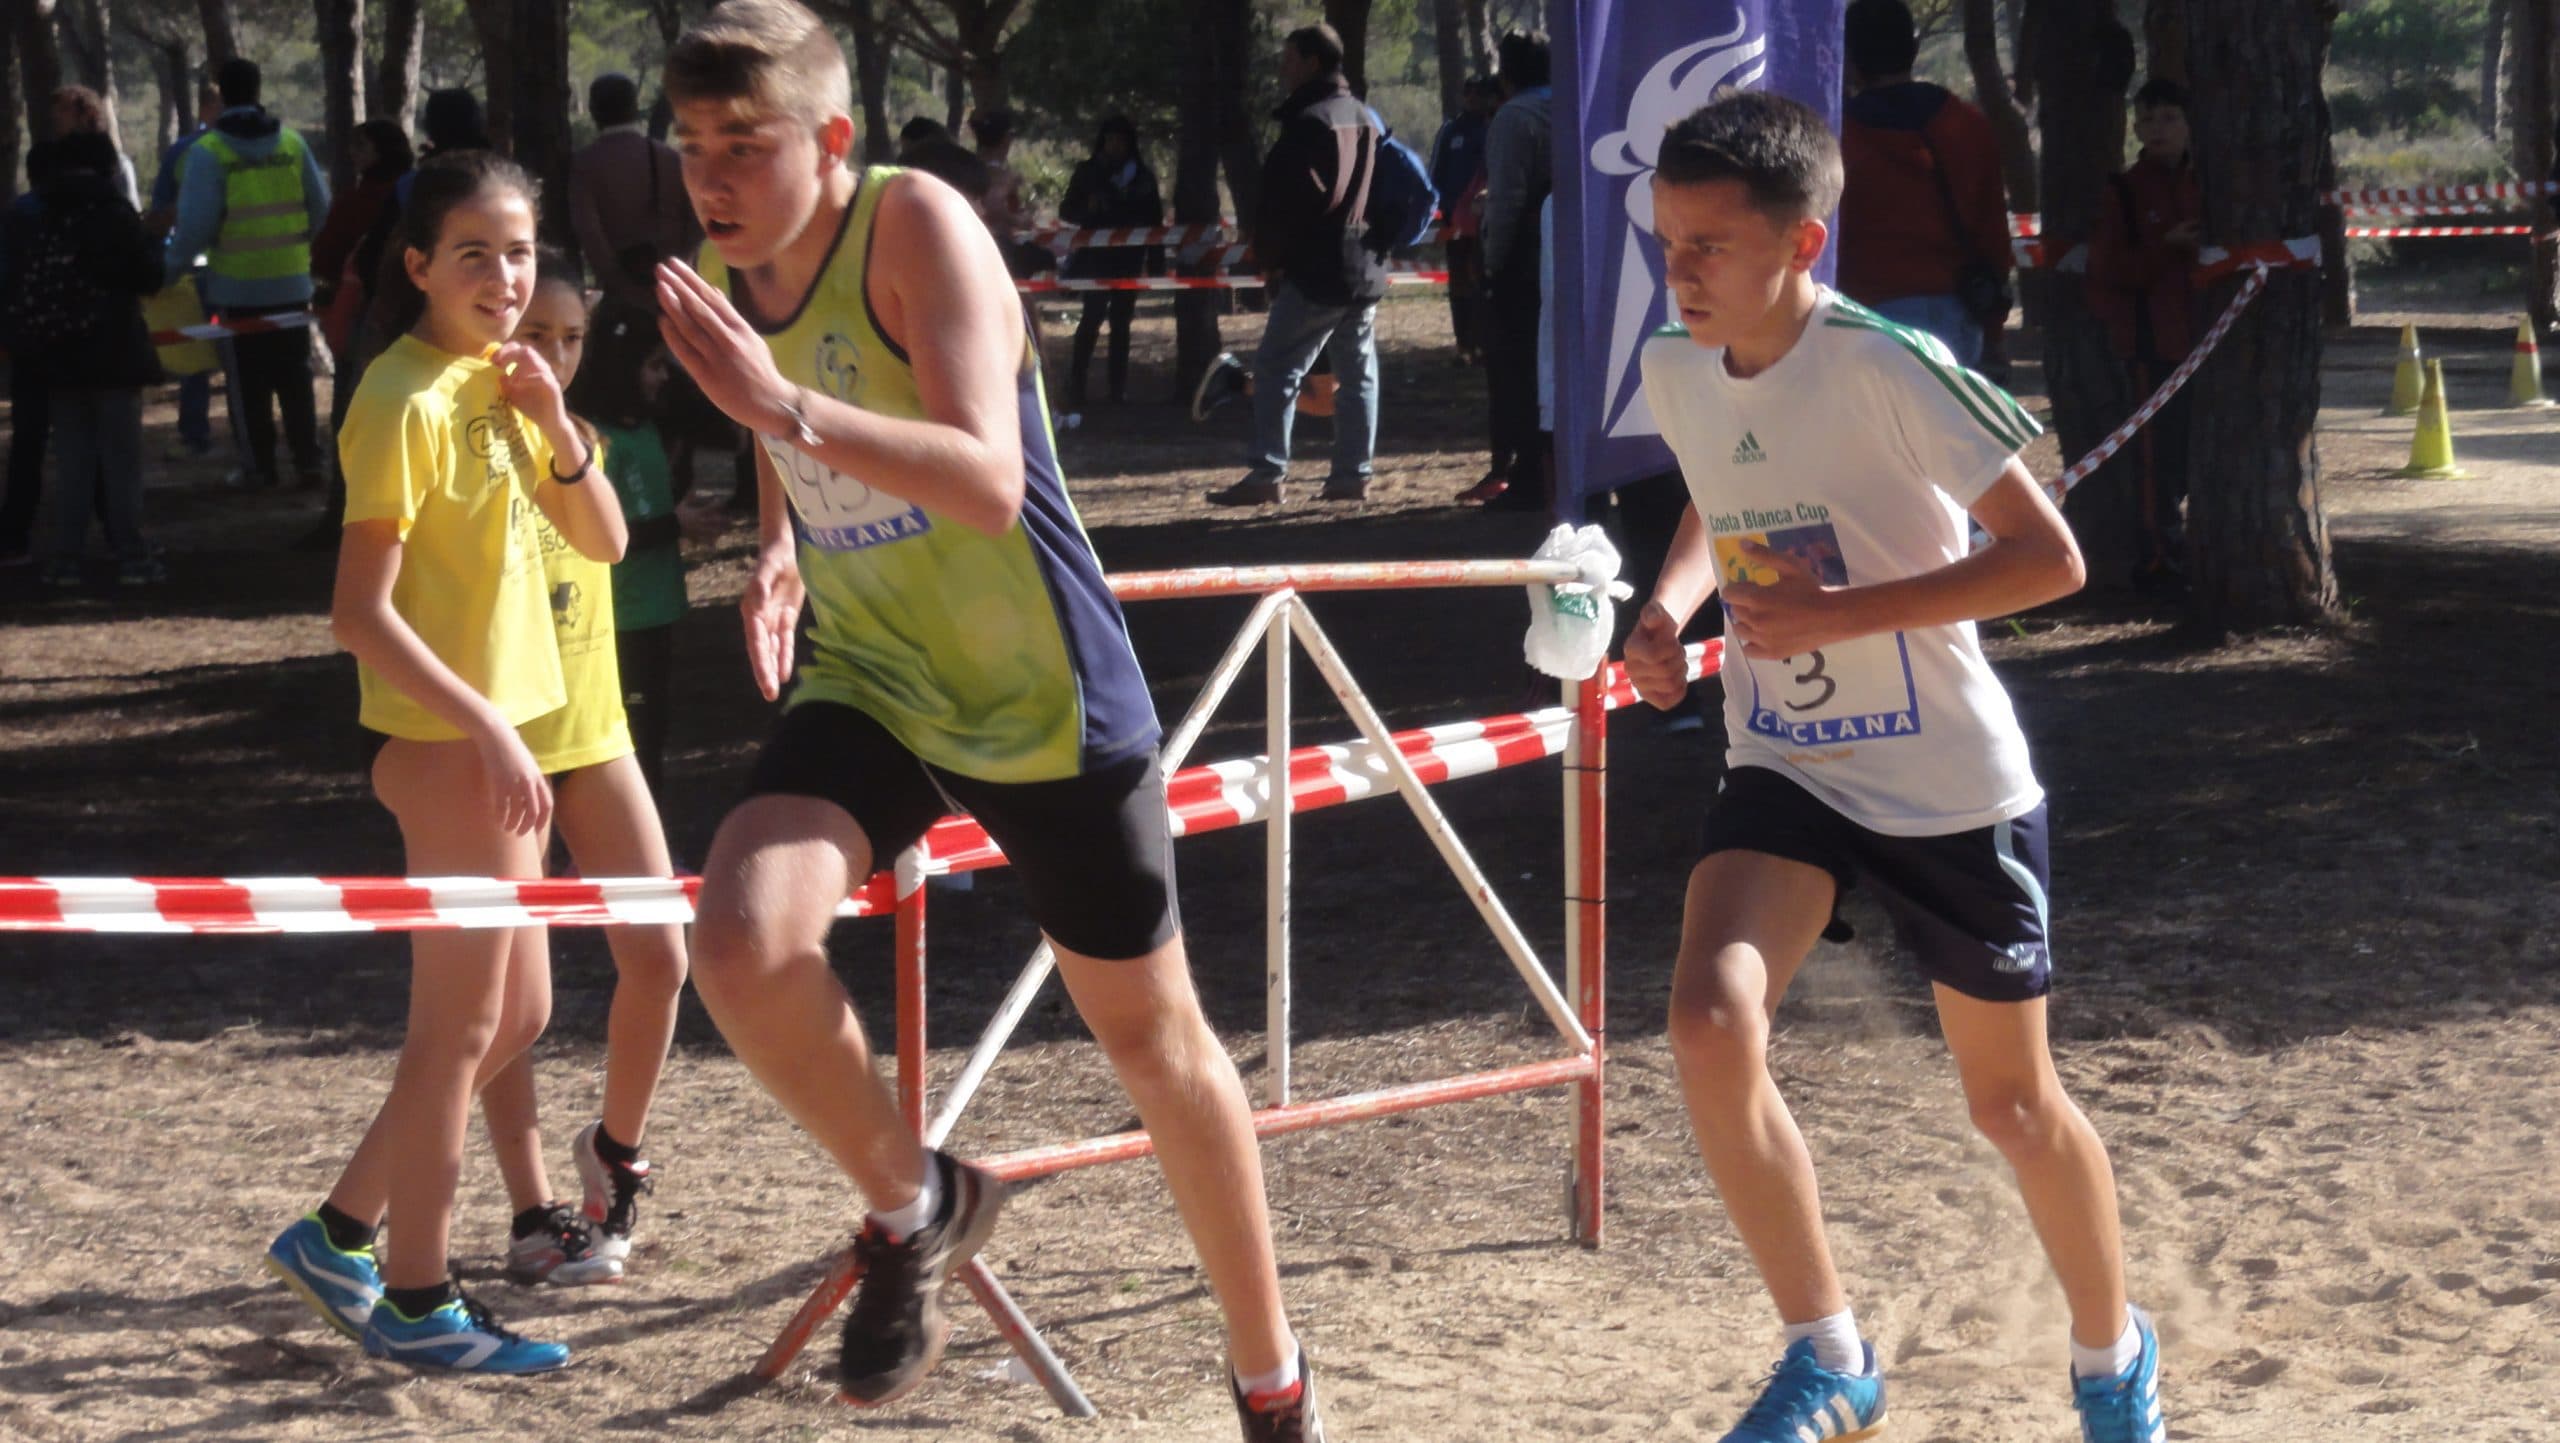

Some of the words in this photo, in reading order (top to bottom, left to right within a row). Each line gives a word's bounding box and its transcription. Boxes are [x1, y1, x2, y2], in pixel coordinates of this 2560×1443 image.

[1708, 512, 1742, 532] Costa
[1741, 508, 1793, 529] Blanca
[1795, 502, 1830, 524] Cup
[1783, 649, 1837, 712] 3
[1756, 710, 1915, 743] CHCLANA
